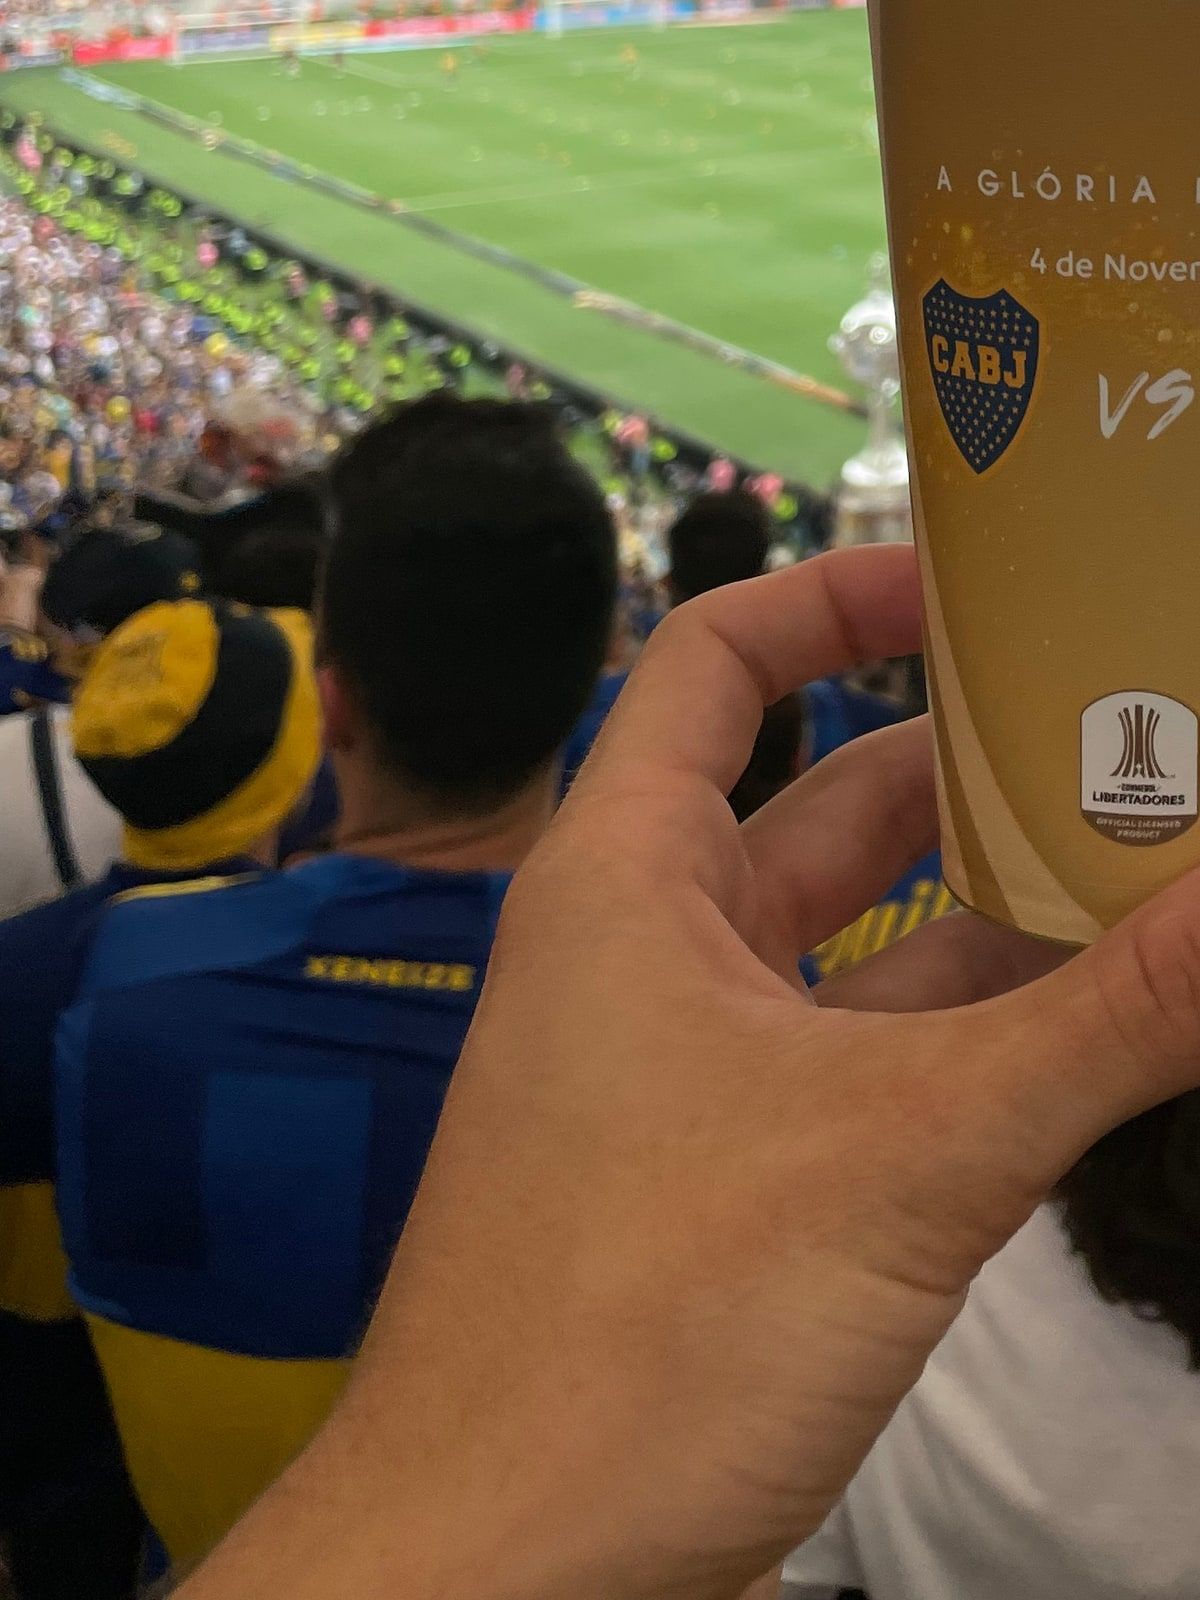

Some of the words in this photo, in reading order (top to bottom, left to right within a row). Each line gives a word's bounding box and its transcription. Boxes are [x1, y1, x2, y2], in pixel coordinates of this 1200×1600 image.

[937, 165, 953, 192] A
[977, 166, 1157, 204] GLÓRIA
[1030, 247, 1047, 275] 4
[1056, 250, 1094, 279] de
[931, 334, 1028, 389] CABJ
[1092, 791, 1186, 806] LIBERTADORES
